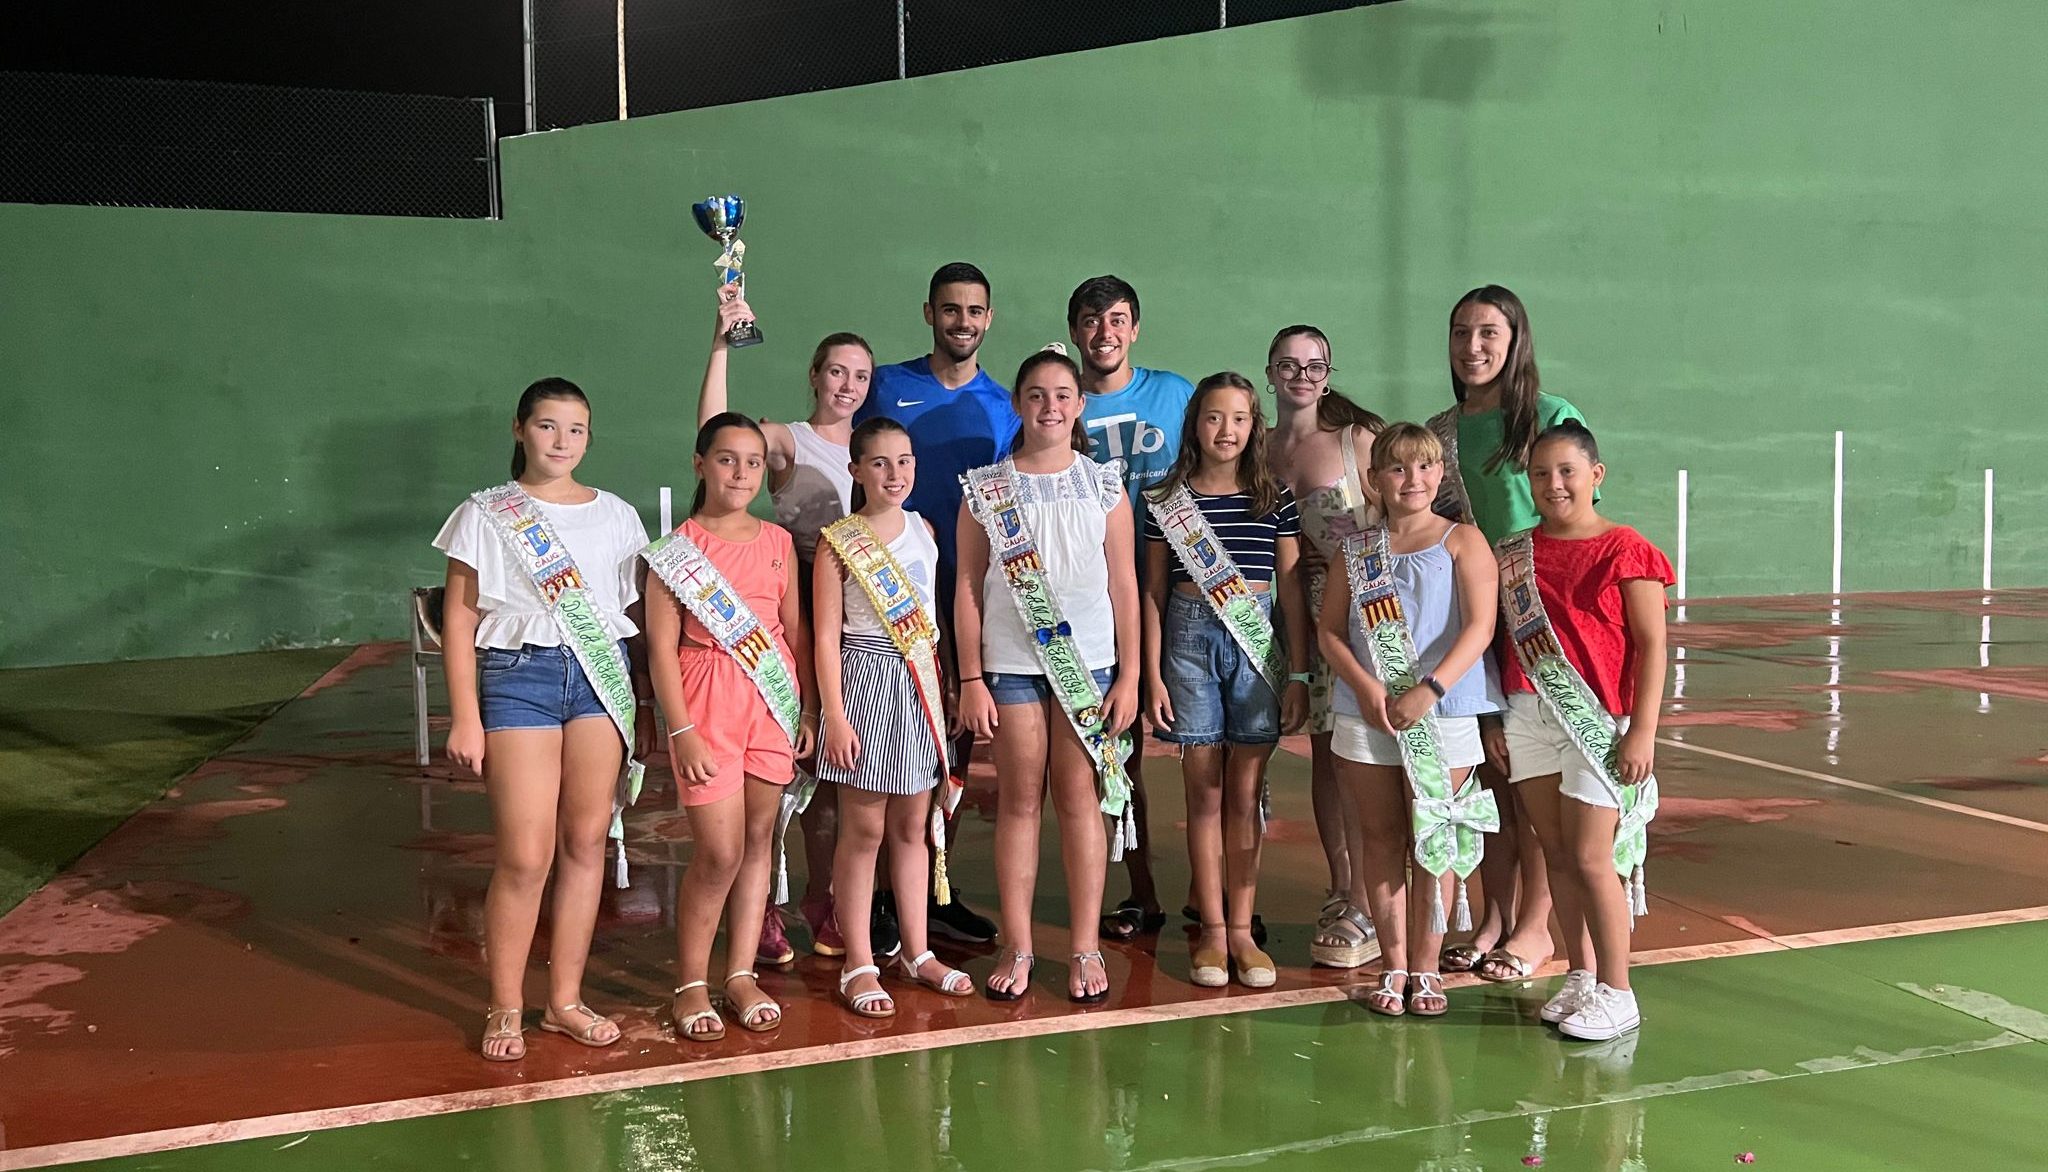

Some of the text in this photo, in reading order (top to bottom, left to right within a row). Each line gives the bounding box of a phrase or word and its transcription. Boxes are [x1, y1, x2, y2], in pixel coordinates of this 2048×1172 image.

[1087, 412, 1165, 459] Tb
[1164, 500, 1184, 516] 2022
[667, 551, 689, 570] 2022
[1235, 610, 1270, 650] DAMA
[560, 600, 632, 715] DAMA INFANTIL
[1377, 632, 1409, 678] DAMA
[764, 666, 792, 707] DAMA
[1540, 670, 1585, 715] DAMA
